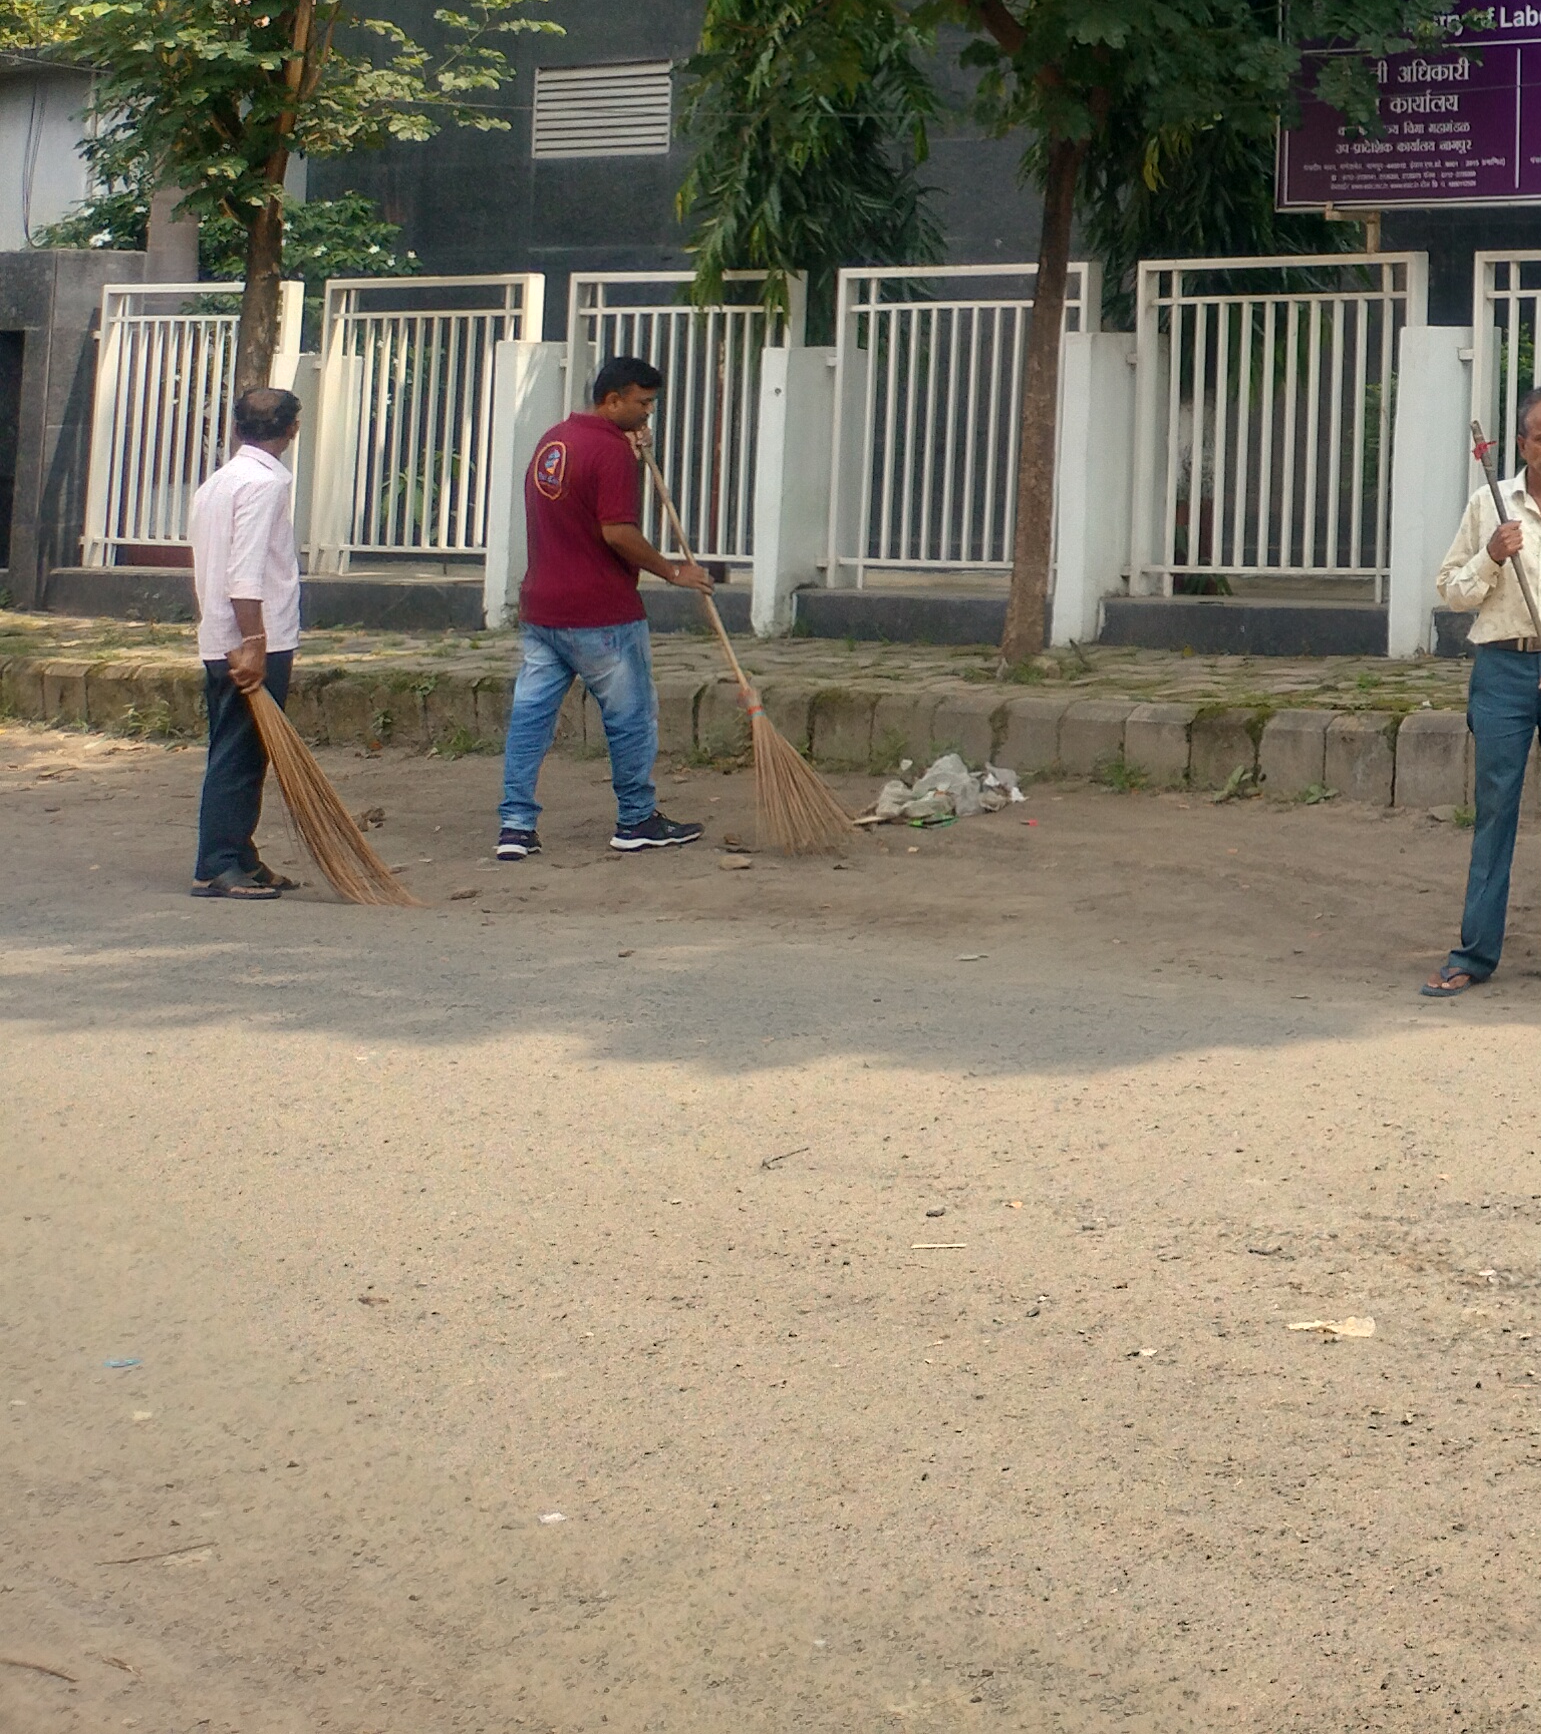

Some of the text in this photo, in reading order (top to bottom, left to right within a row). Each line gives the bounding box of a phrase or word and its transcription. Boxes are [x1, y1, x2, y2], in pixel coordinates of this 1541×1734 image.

[1397, 57, 1470, 83] अधिकारी
[1390, 90, 1459, 114] कार्यालय
[1397, 138, 1436, 153] कार्यालय
